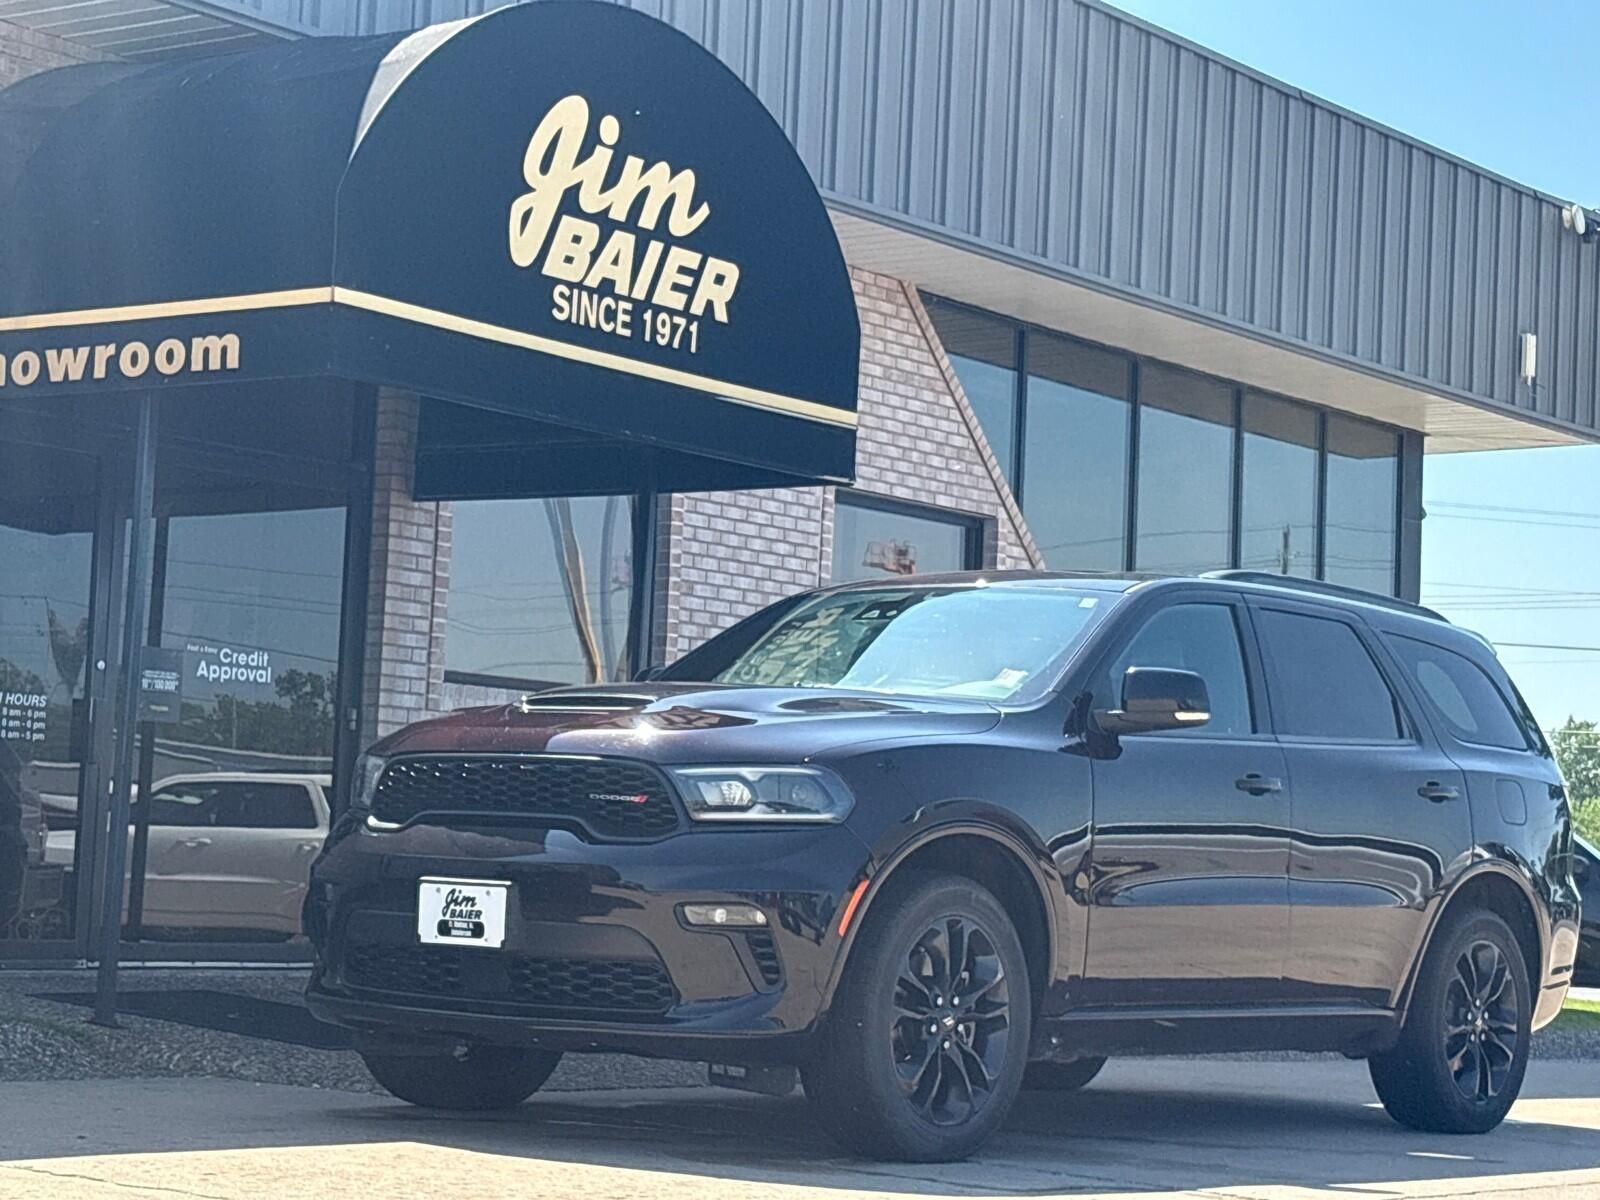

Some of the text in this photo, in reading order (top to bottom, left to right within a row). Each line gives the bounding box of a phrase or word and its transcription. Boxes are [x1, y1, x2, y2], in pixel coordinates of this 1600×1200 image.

[509, 95, 711, 267] Jim
[542, 215, 739, 323] BAIER
[551, 284, 698, 354] SINCE 1971
[0, 333, 240, 387] owroom
[220, 648, 269, 667] Credit
[196, 660, 272, 683] Approval
[5, 693, 47, 707] HOURS
[589, 794, 638, 802] DODGE
[442, 888, 477, 918] Jim
[449, 908, 483, 920] BAIER
